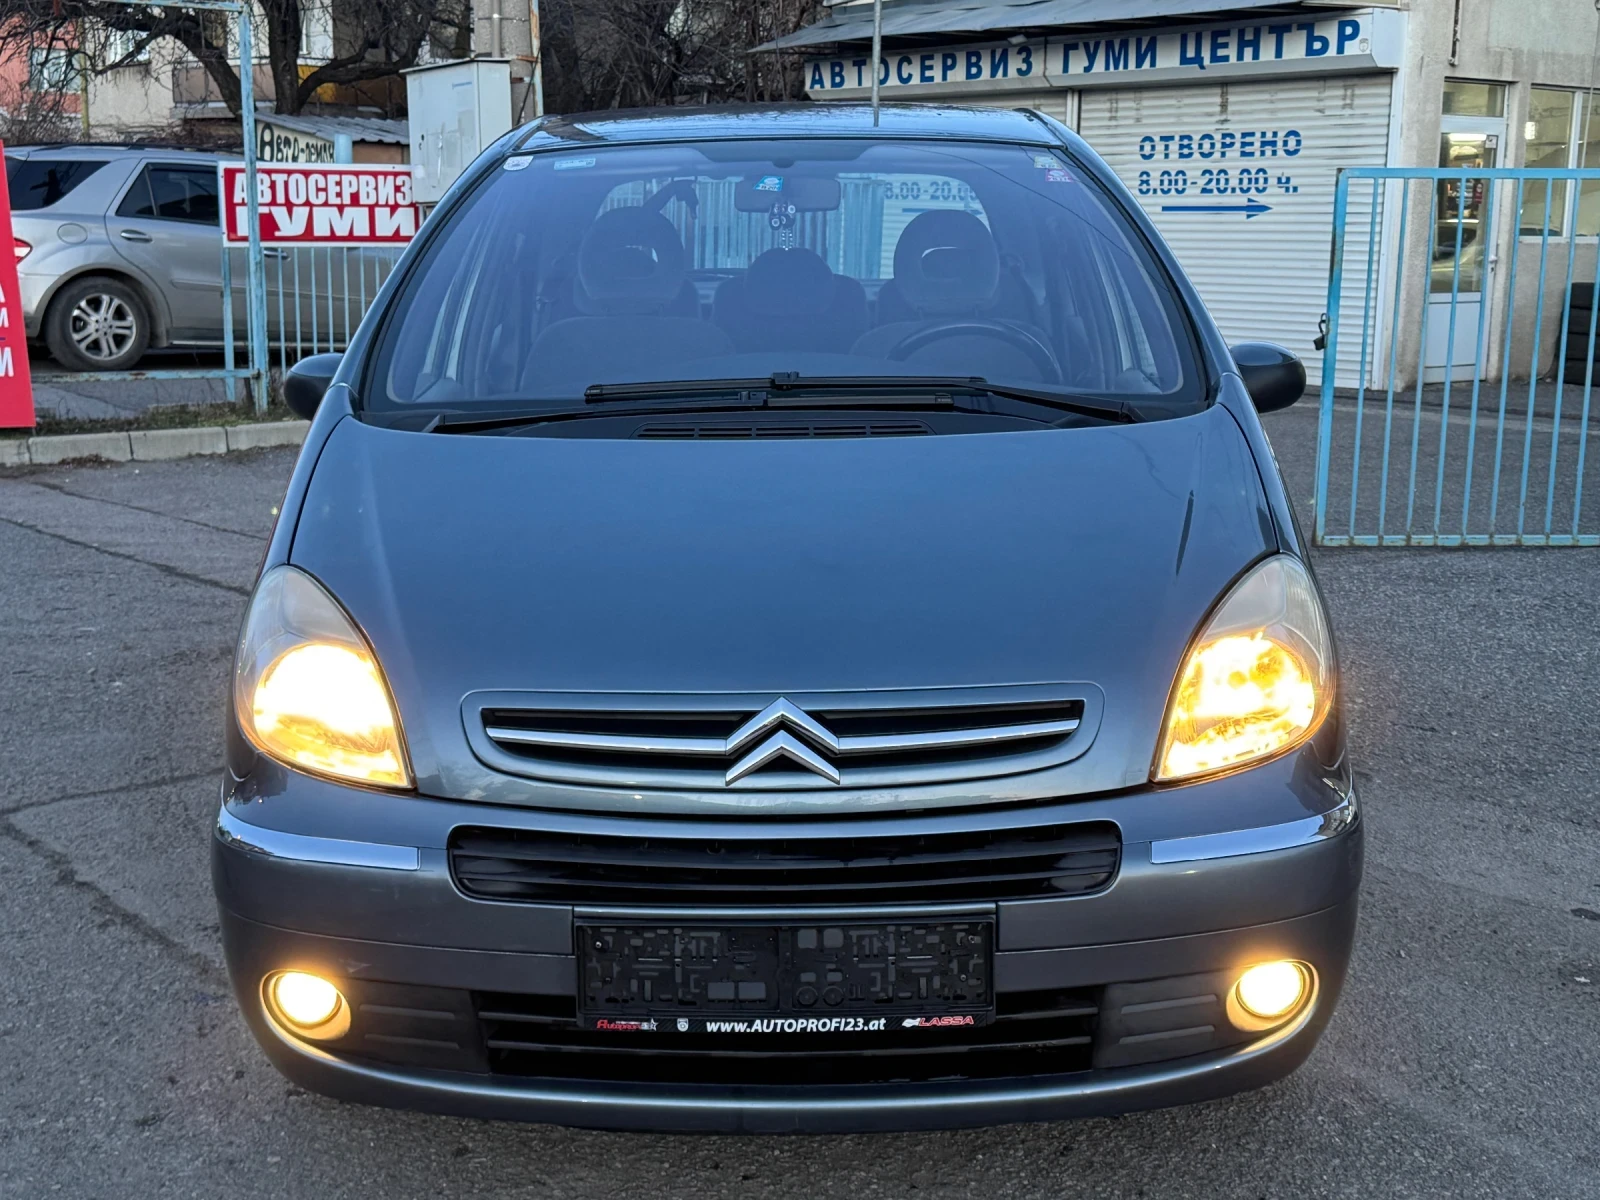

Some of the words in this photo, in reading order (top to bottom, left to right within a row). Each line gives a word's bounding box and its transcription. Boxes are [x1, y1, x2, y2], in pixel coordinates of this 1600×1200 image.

[809, 46, 1033, 89] АВТОСЕРВИЗ
[1062, 35, 1158, 74] ГУМИ
[1179, 19, 1361, 70] ЦЕНТЪР
[1139, 130, 1302, 161] ОТВОРЕНО
[233, 172, 412, 206] АВТОСЕРВИЗ
[1138, 168, 1269, 195] 8.00-20.00
[235, 205, 416, 237] ГУМИ
[919, 1016, 975, 1027] LASSA
